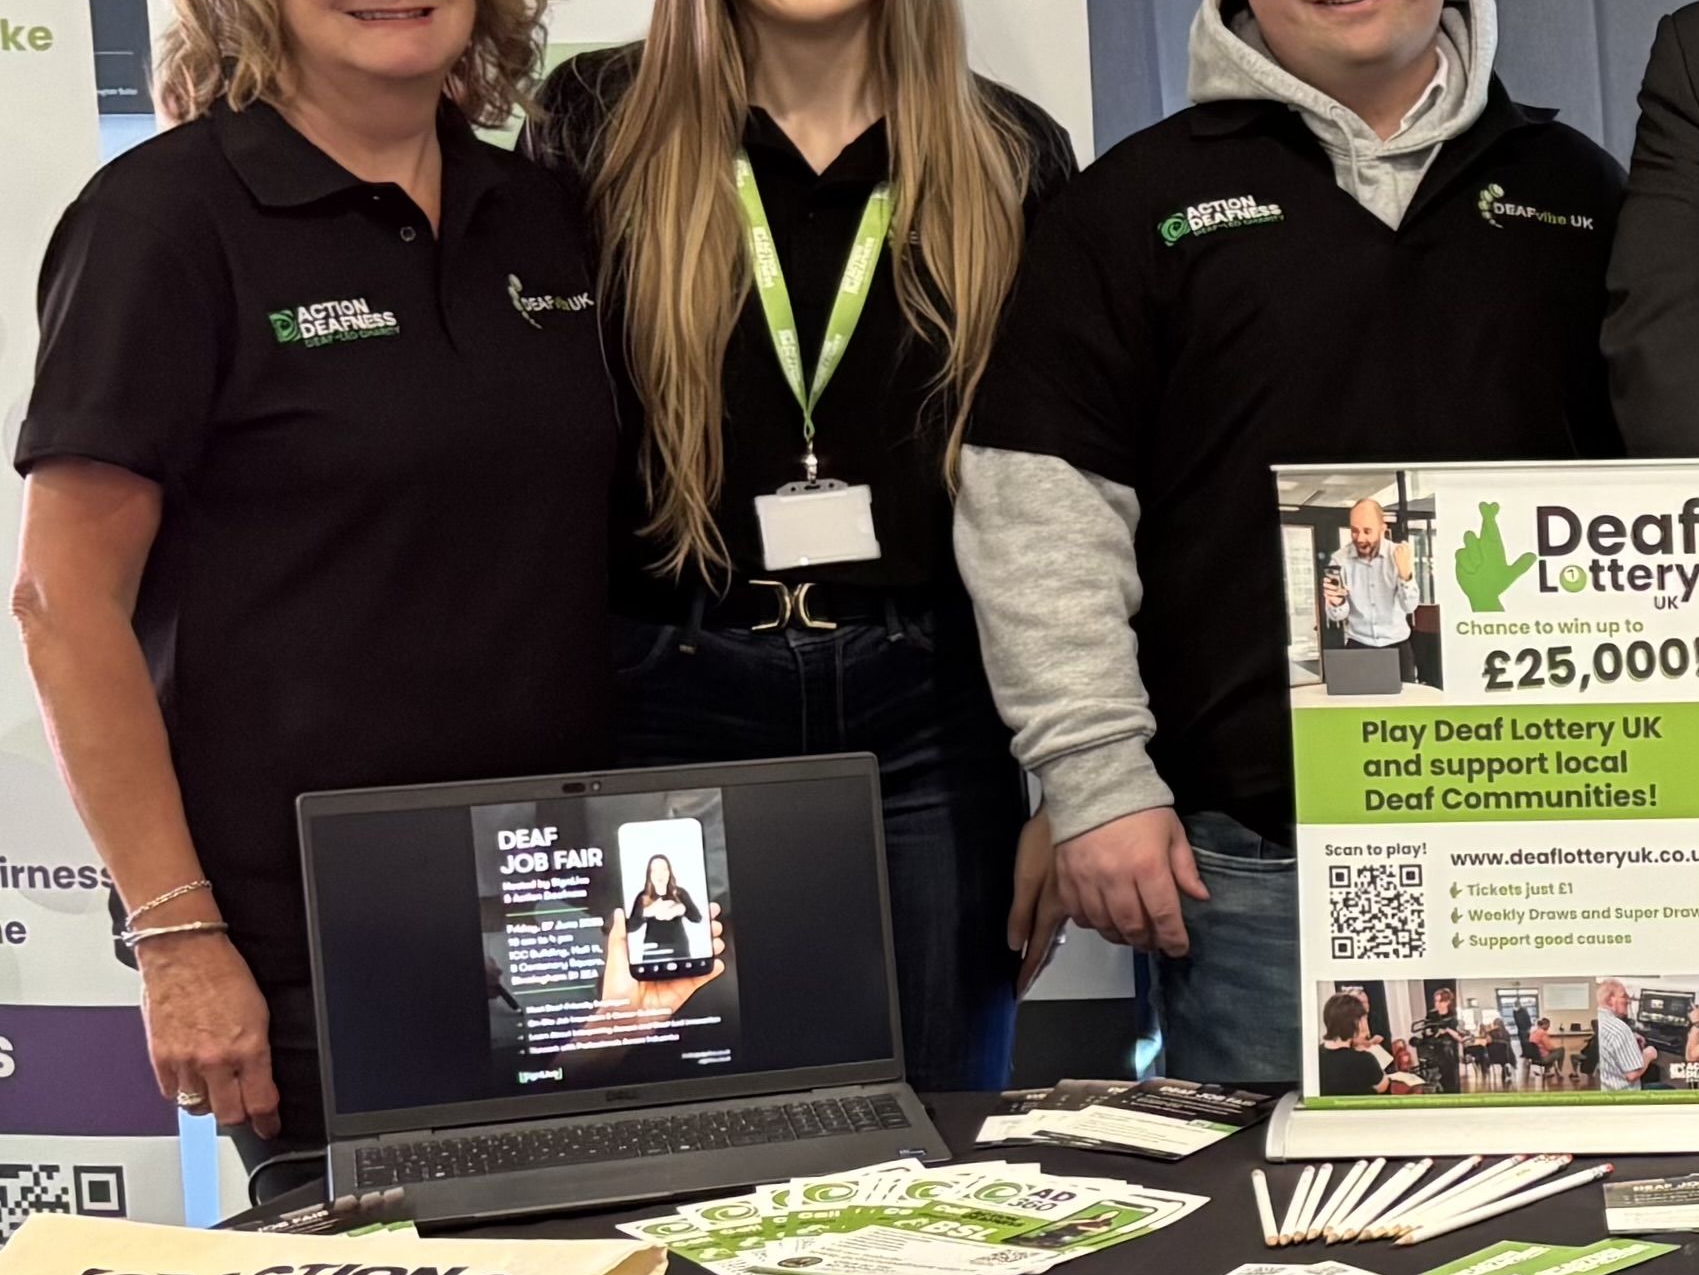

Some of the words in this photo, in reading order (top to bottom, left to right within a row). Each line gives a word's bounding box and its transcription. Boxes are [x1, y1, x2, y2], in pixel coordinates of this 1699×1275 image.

[1186, 195, 1256, 218] ACTION
[1190, 204, 1282, 231] DEAFNESS
[298, 297, 369, 322] ACTION
[300, 312, 397, 338] DEAFNESS
[1456, 620, 1528, 637] Chance
[1534, 620, 1552, 635] to
[1558, 619, 1590, 635] win
[1596, 621, 1621, 638] up
[1626, 618, 1643, 634] to
[1361, 719, 1426, 748] Play
[1435, 719, 1503, 744] Deaf
[1510, 717, 1616, 747] Lottery
[1623, 717, 1662, 738] UK
[1363, 753, 1422, 779] and
[1430, 751, 1549, 783] support
[1556, 750, 1627, 774] local
[1365, 787, 1435, 811] Deaf
[1442, 783, 1657, 811] Communities!
[498, 827, 557, 851] DEAF
[500, 852, 549, 875] JOB
[554, 848, 602, 868] FAIR
[1469, 933, 1530, 949] Support
[1534, 932, 1572, 949] good
[1575, 932, 1632, 946] causes
[1030, 1187, 1077, 1205] AD
